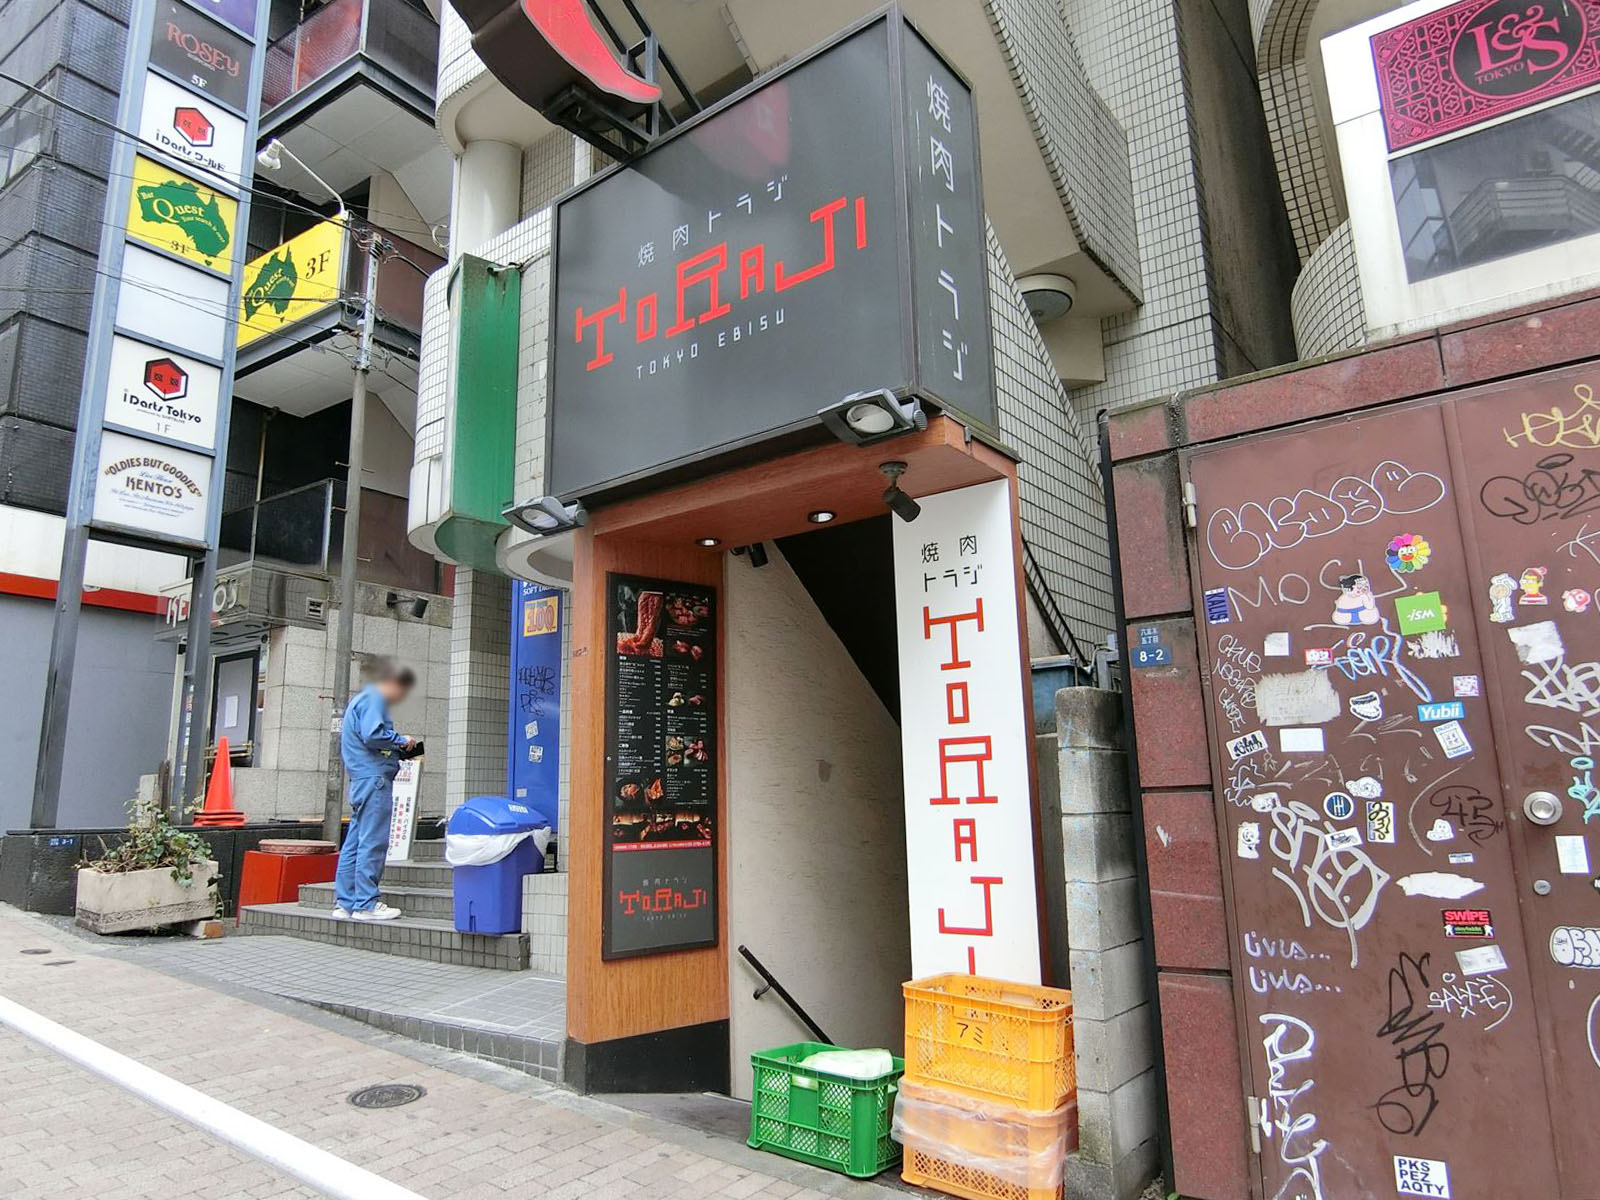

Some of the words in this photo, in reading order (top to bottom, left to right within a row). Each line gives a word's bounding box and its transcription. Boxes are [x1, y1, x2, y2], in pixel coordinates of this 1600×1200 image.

[166, 22, 241, 77] ROSEY
[191, 74, 208, 88] 5F
[1474, 62, 1525, 86] TOKYO
[153, 198, 205, 223] Quest
[638, 175, 788, 268] 焼肉トラジ
[927, 75, 967, 381] 焼肉トラジ
[305, 249, 331, 280] 3F
[251, 268, 283, 307] Quest
[574, 196, 867, 372] TORAJI
[636, 343, 698, 380] TOKYO
[718, 308, 785, 348] EBISU
[165, 405, 202, 424] Tokyo
[143, 457, 164, 470] BUT
[126, 476, 183, 499] KENTO'S
[920, 534, 978, 563] 焼肉
[923, 563, 983, 593] トラジ
[1140, 648, 1164, 662] 8-2
[923, 597, 1004, 976] TORAJI
[619, 887, 707, 915] TORAJI
[1444, 910, 1490, 921] SWIPE
[1398, 1158, 1430, 1172] PKS
[1400, 1169, 1431, 1183] PEZ
[1401, 1180, 1445, 1195] AQTY
